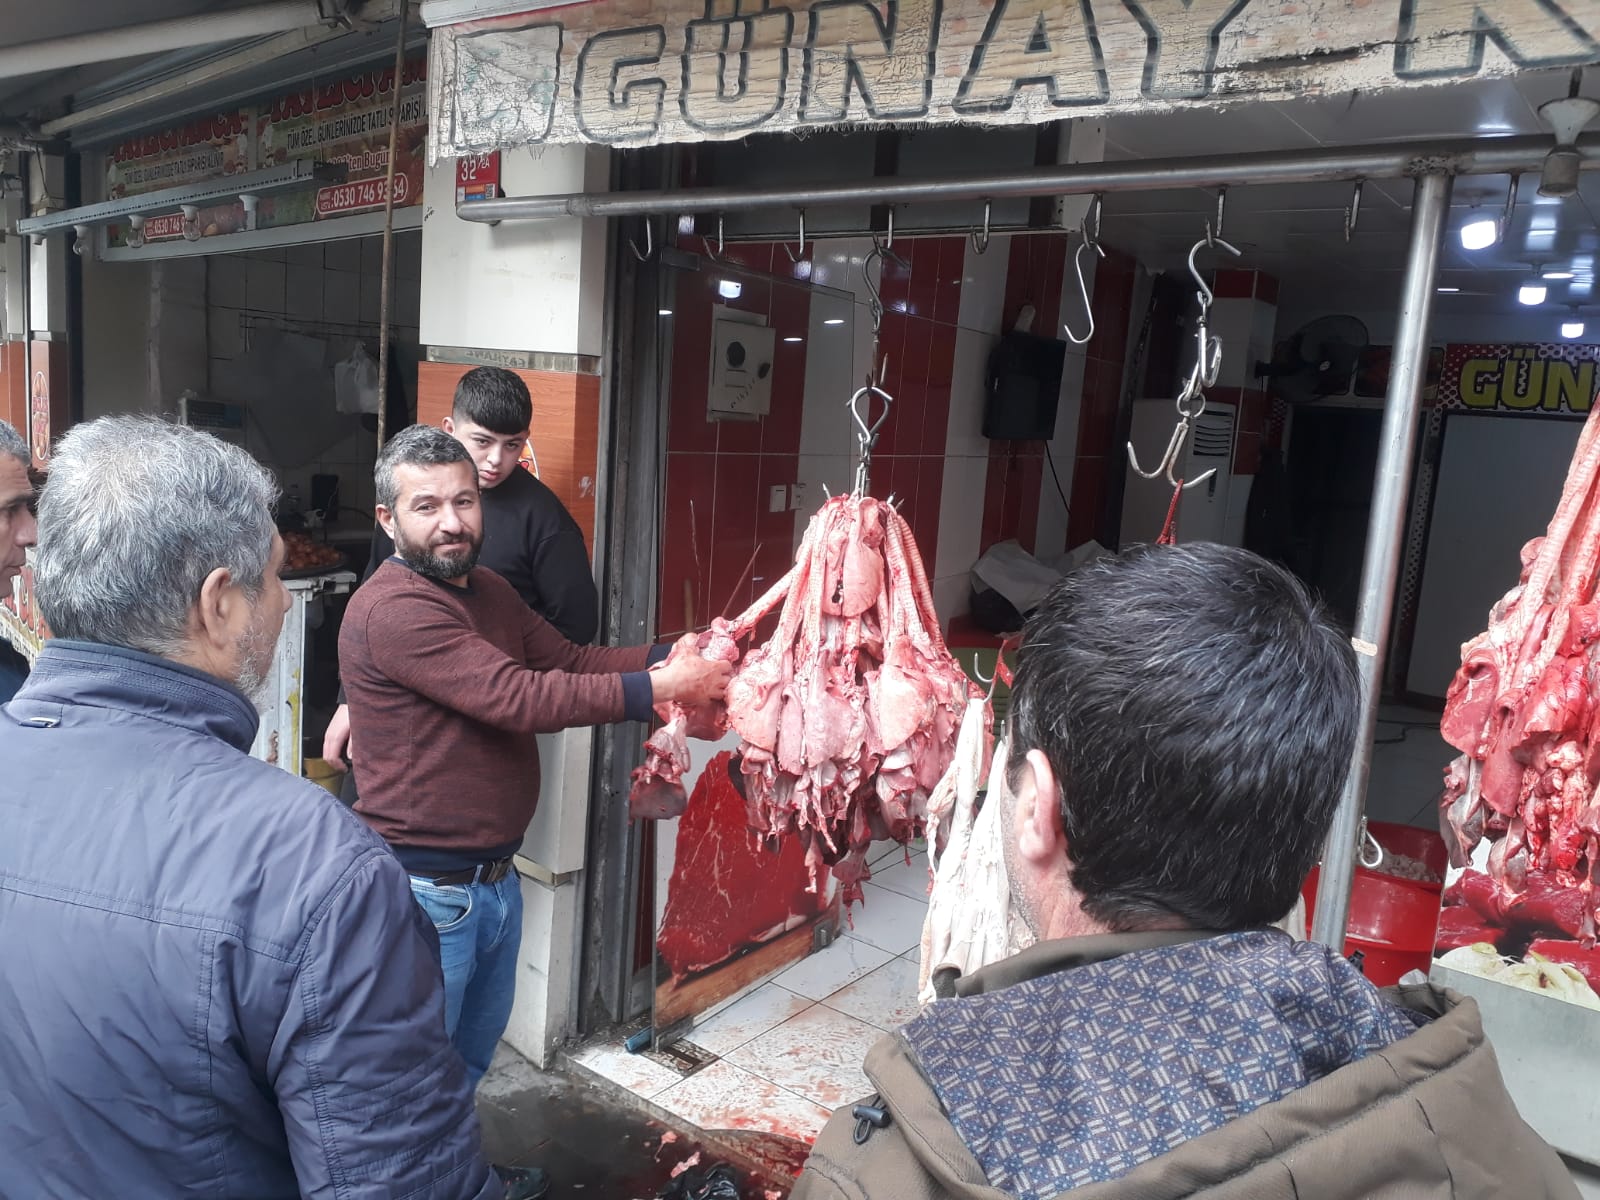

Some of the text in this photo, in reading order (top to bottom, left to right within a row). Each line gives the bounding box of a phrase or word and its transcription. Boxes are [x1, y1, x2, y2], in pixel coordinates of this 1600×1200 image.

[574, 0, 1252, 144] GÜNAY
[358, 183, 375, 204] 746
[1459, 345, 1595, 412] GÜN
